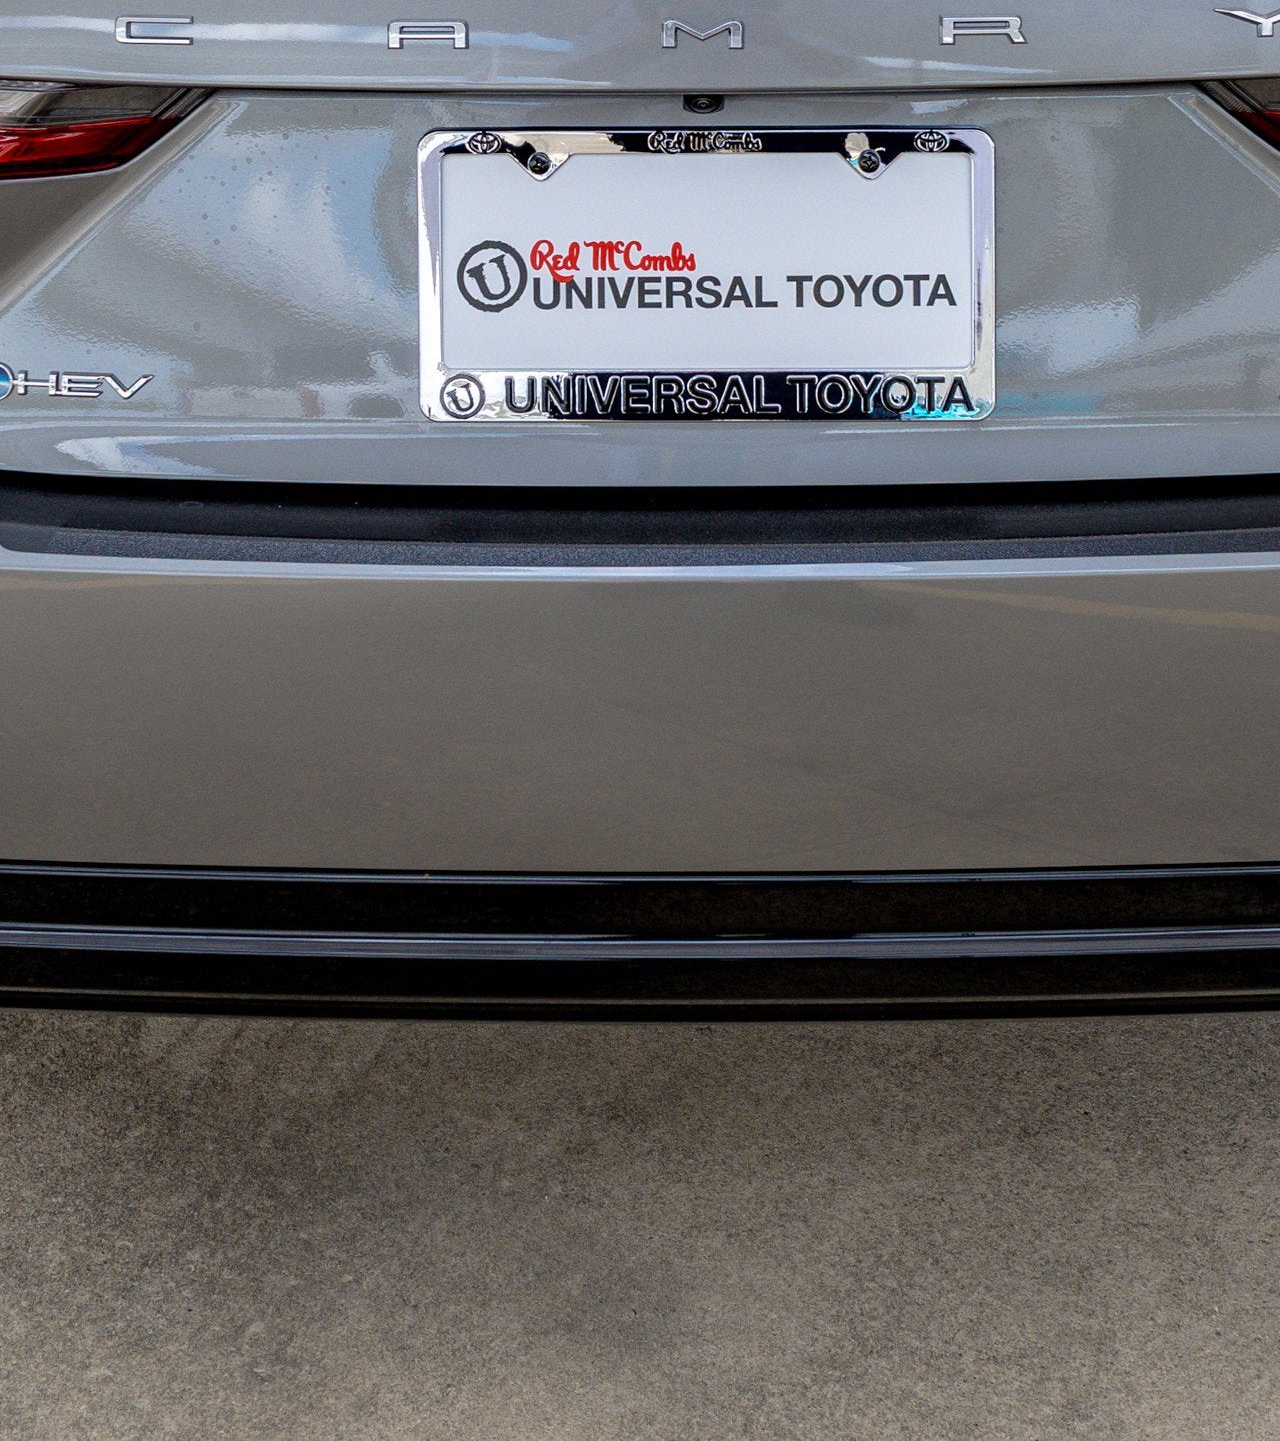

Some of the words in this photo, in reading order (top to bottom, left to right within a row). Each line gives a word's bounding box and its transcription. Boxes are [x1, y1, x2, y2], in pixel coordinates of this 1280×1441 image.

[648, 130, 685, 154] Red
[686, 130, 762, 154] McCombs
[530, 239, 581, 282] Red
[584, 239, 696, 272] McCombs
[533, 275, 778, 310] UNIVERSAL
[786, 273, 958, 308] TOYOTA
[17, 370, 155, 400] HEV
[505, 375, 780, 415] UNIVERSAL
[786, 374, 975, 414] TOYOTA
